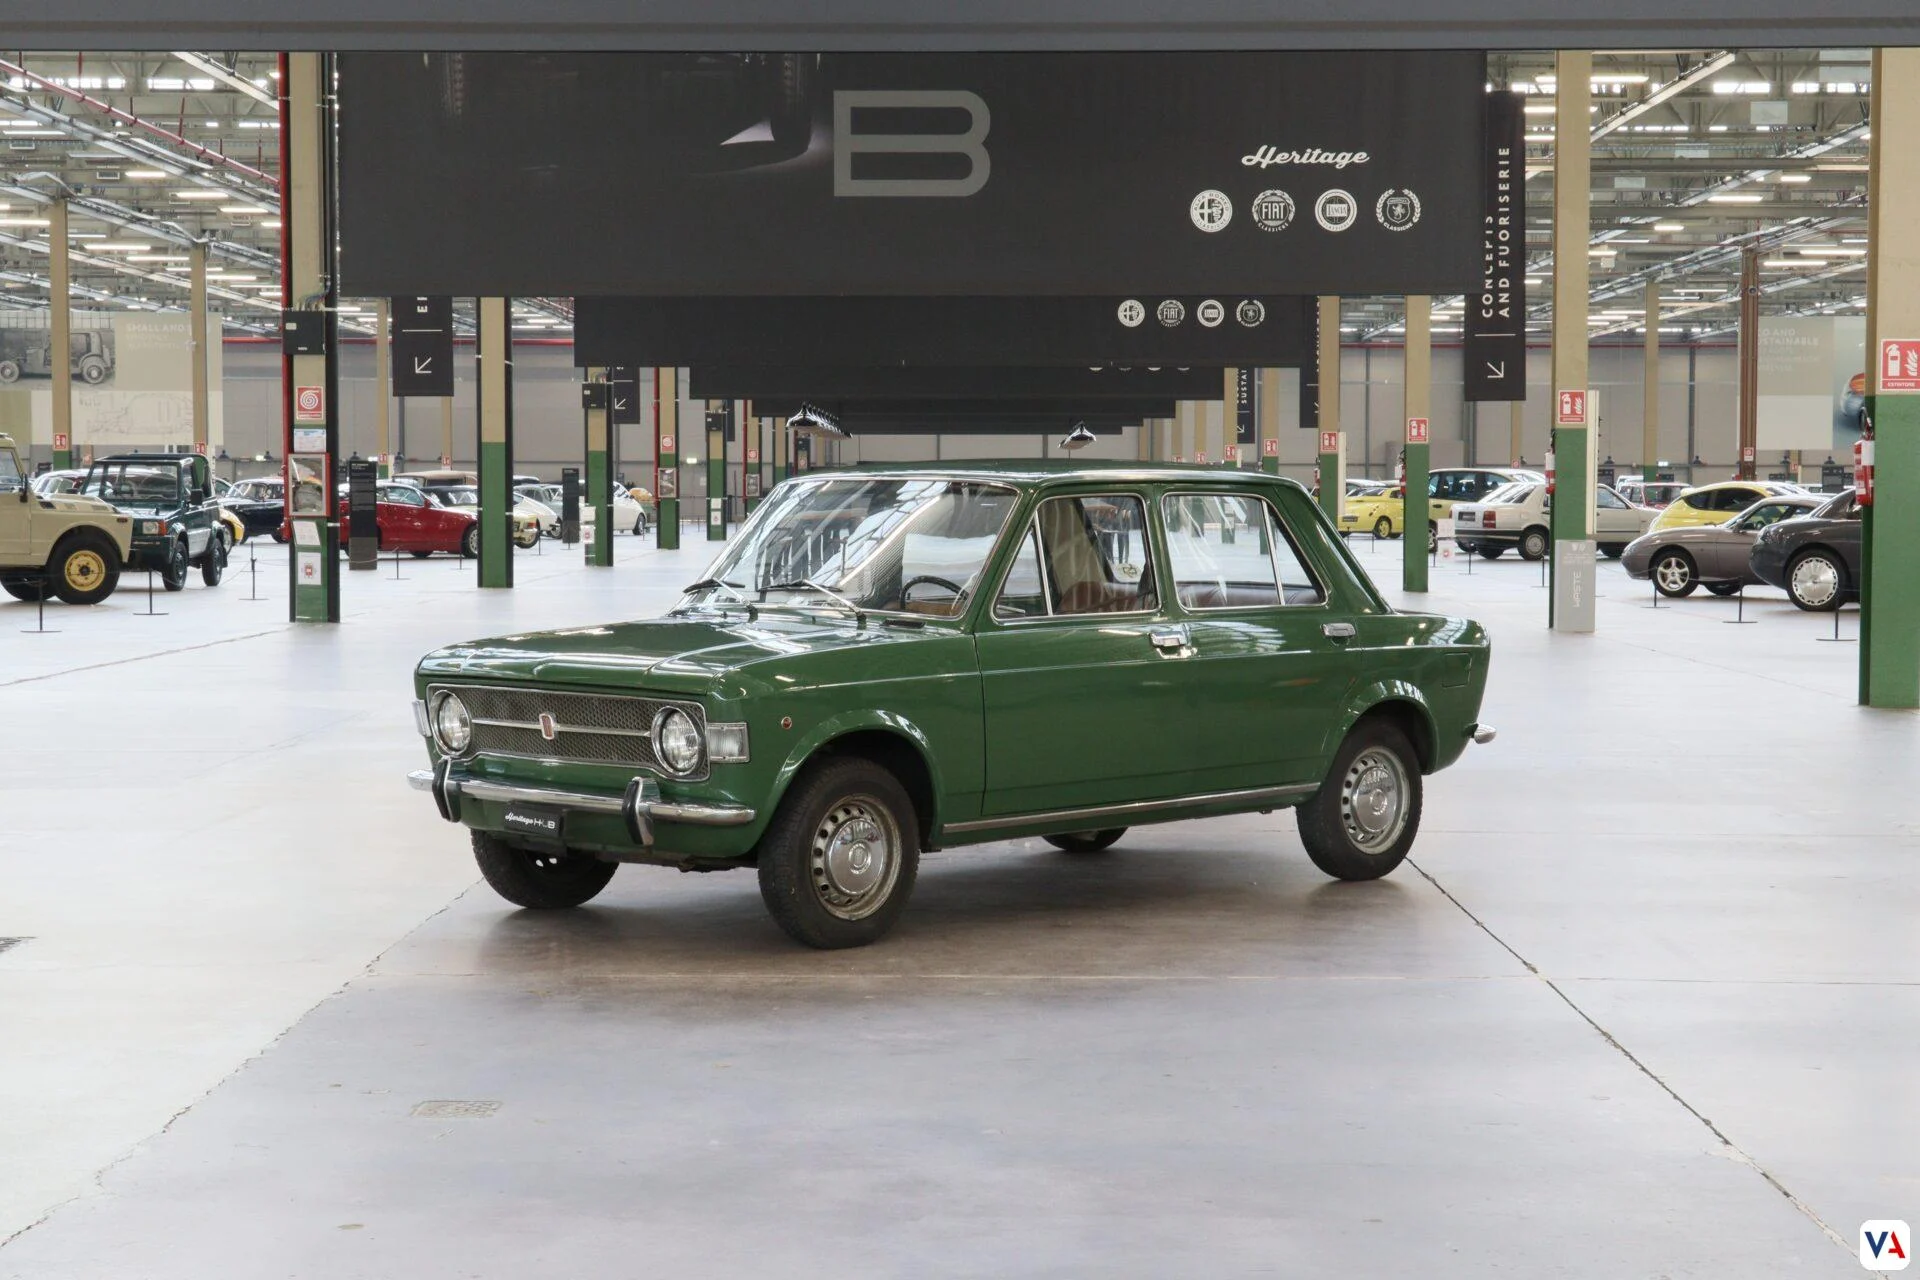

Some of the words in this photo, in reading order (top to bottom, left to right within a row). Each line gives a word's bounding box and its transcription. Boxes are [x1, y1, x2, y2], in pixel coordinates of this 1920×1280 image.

[833, 90, 991, 197] B
[1241, 145, 1370, 169] Heritage
[1261, 202, 1286, 220] FIAT
[1498, 147, 1510, 268] FUORISERIE
[1498, 278, 1510, 318] AND
[1163, 308, 1179, 319] FIAT
[504, 811, 534, 825] Heritage
